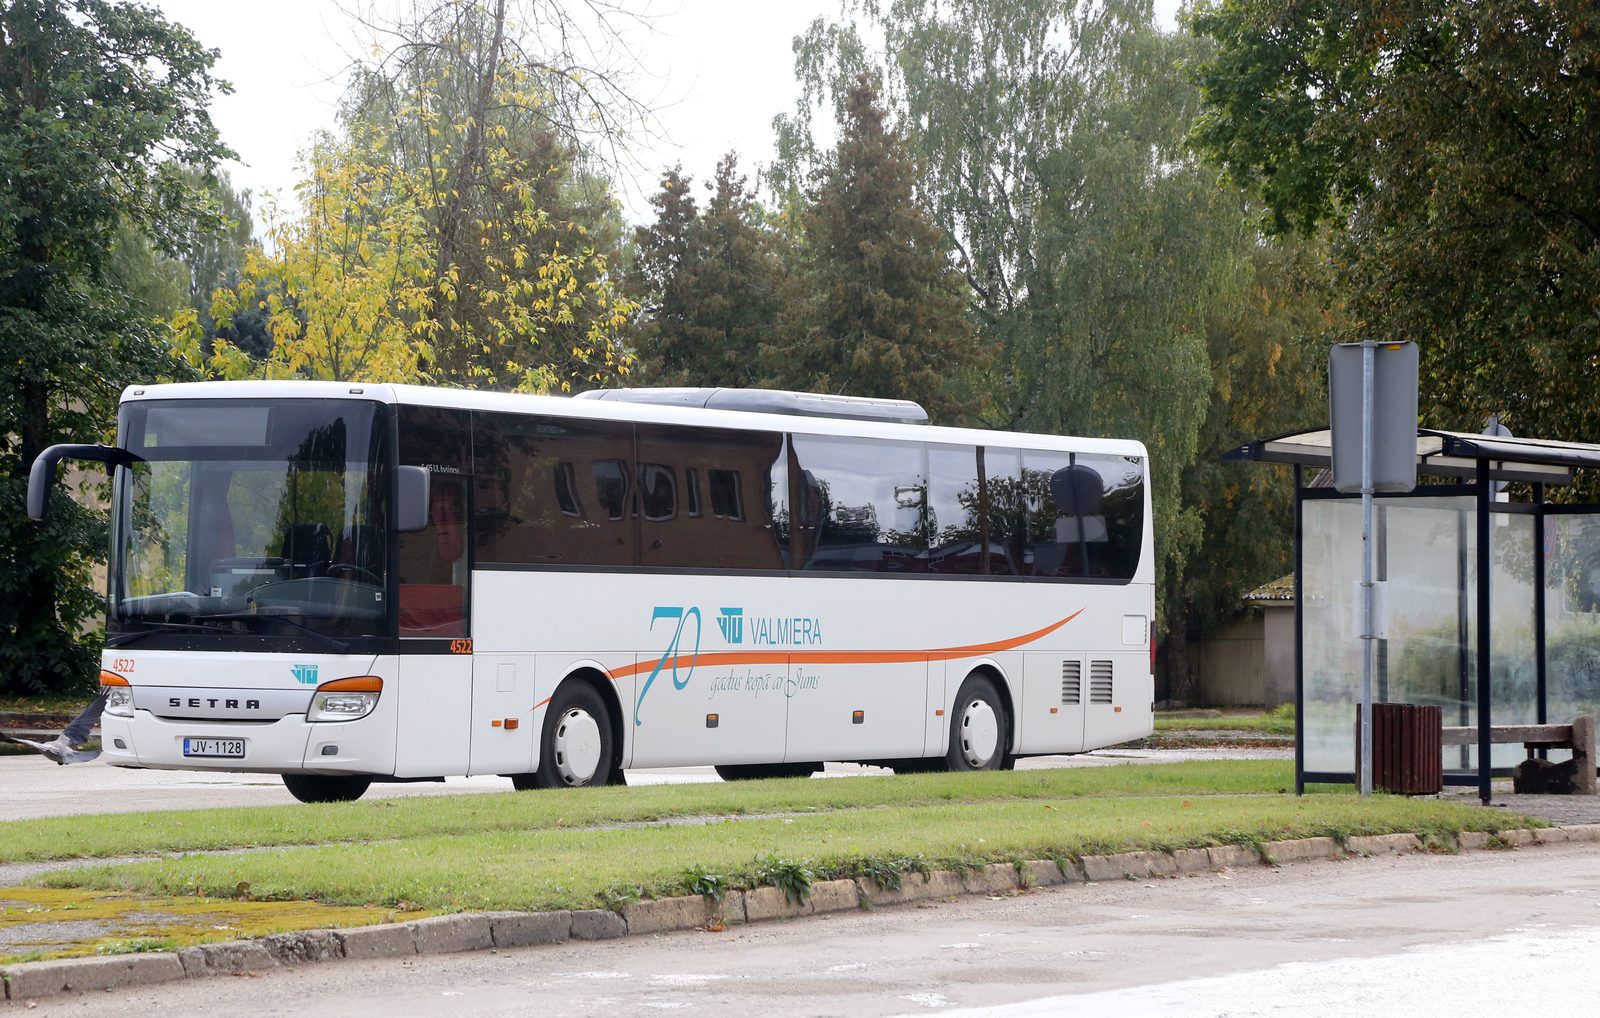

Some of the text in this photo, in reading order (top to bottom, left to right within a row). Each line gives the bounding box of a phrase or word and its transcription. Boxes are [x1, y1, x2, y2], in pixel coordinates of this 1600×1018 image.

[750, 618, 822, 645] VALMIERA
[450, 640, 472, 653] 4522
[112, 659, 135, 673] 4522
[635, 606, 701, 726] 70
[708, 669, 742, 700] gadus
[772, 676, 785, 689] ar
[169, 698, 260, 709] SETRA
[192, 741, 242, 754] JV-1128
